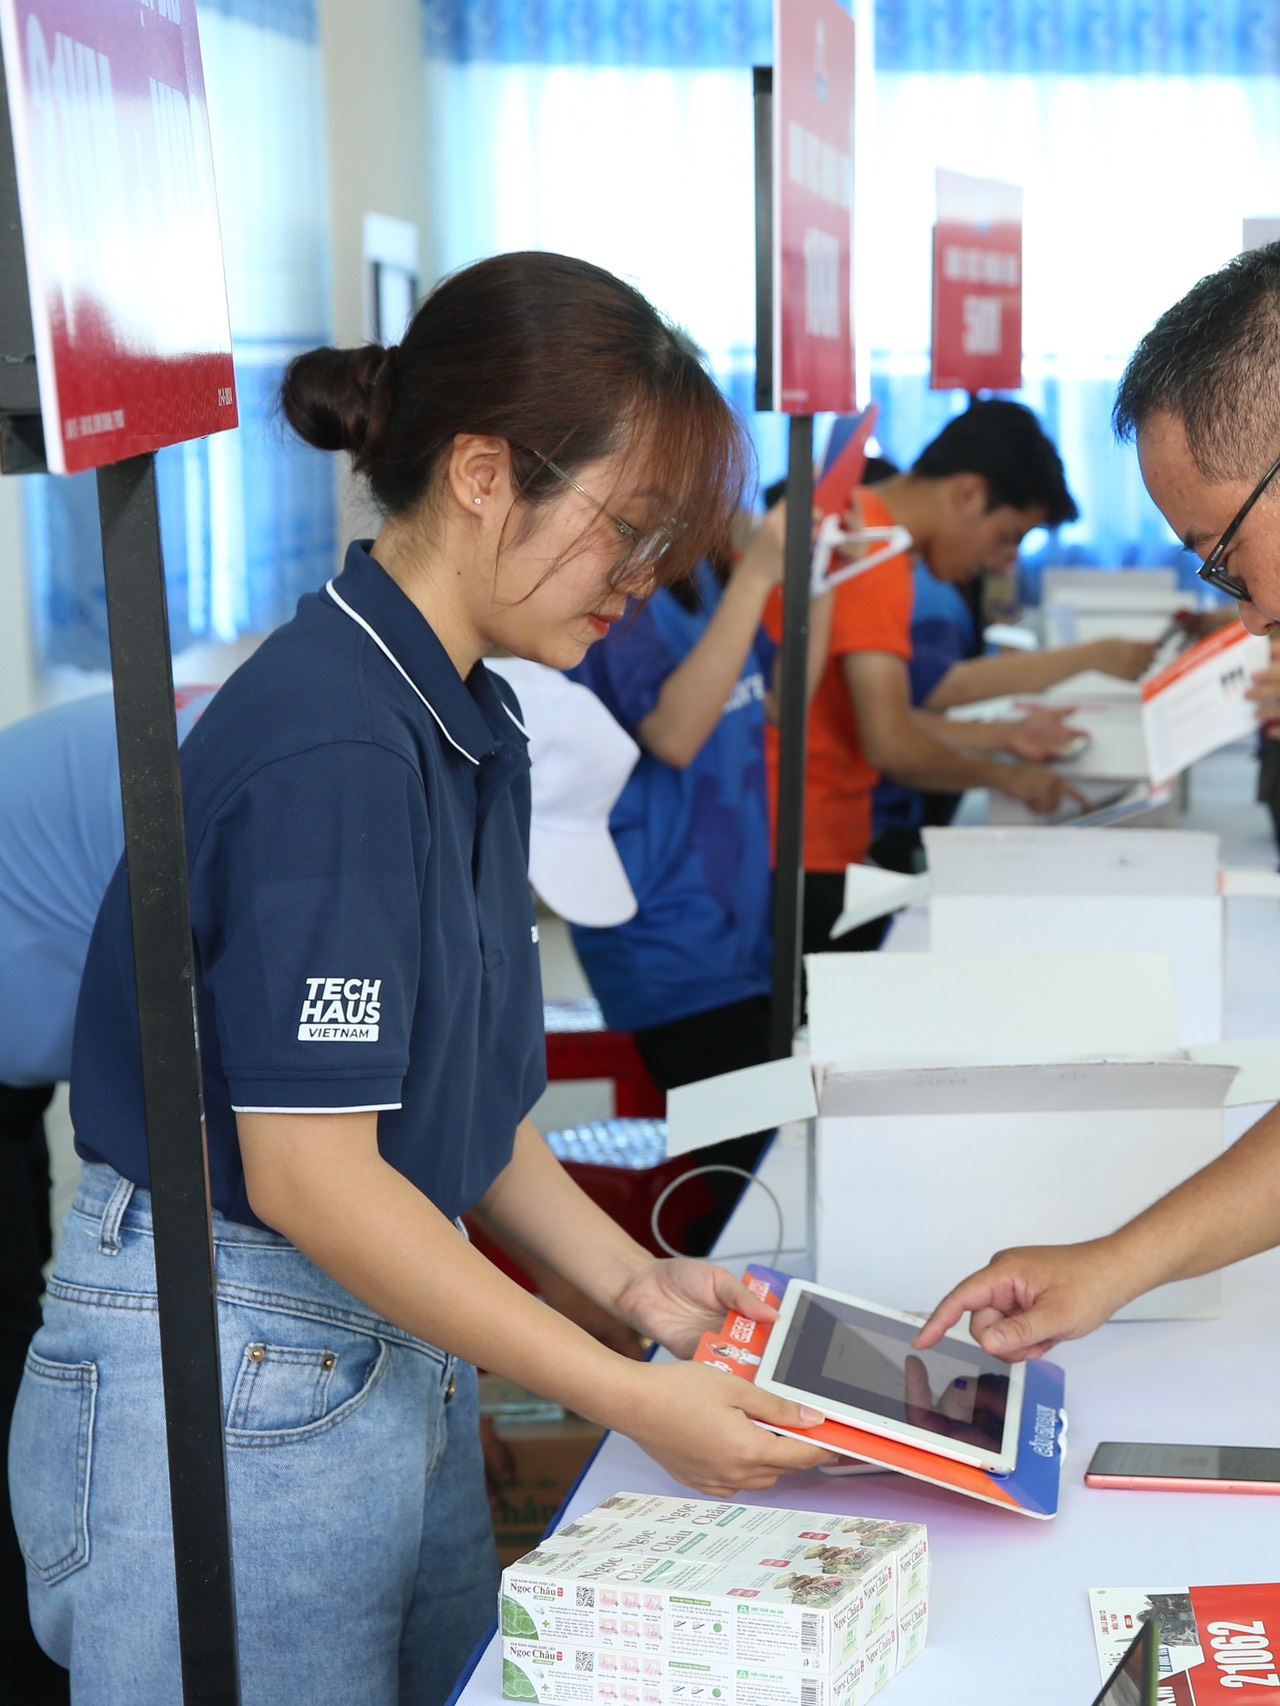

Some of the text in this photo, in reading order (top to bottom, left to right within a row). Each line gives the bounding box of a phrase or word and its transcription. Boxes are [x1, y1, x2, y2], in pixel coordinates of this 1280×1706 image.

[306, 977, 382, 1001] TECH
[300, 1000, 381, 1024] HAUS
[309, 1028, 370, 1038] VIETNAM
[533, 1585, 556, 1596] Châu
[533, 1648, 555, 1660] Châu
[1206, 1620, 1280, 1688] 21062
